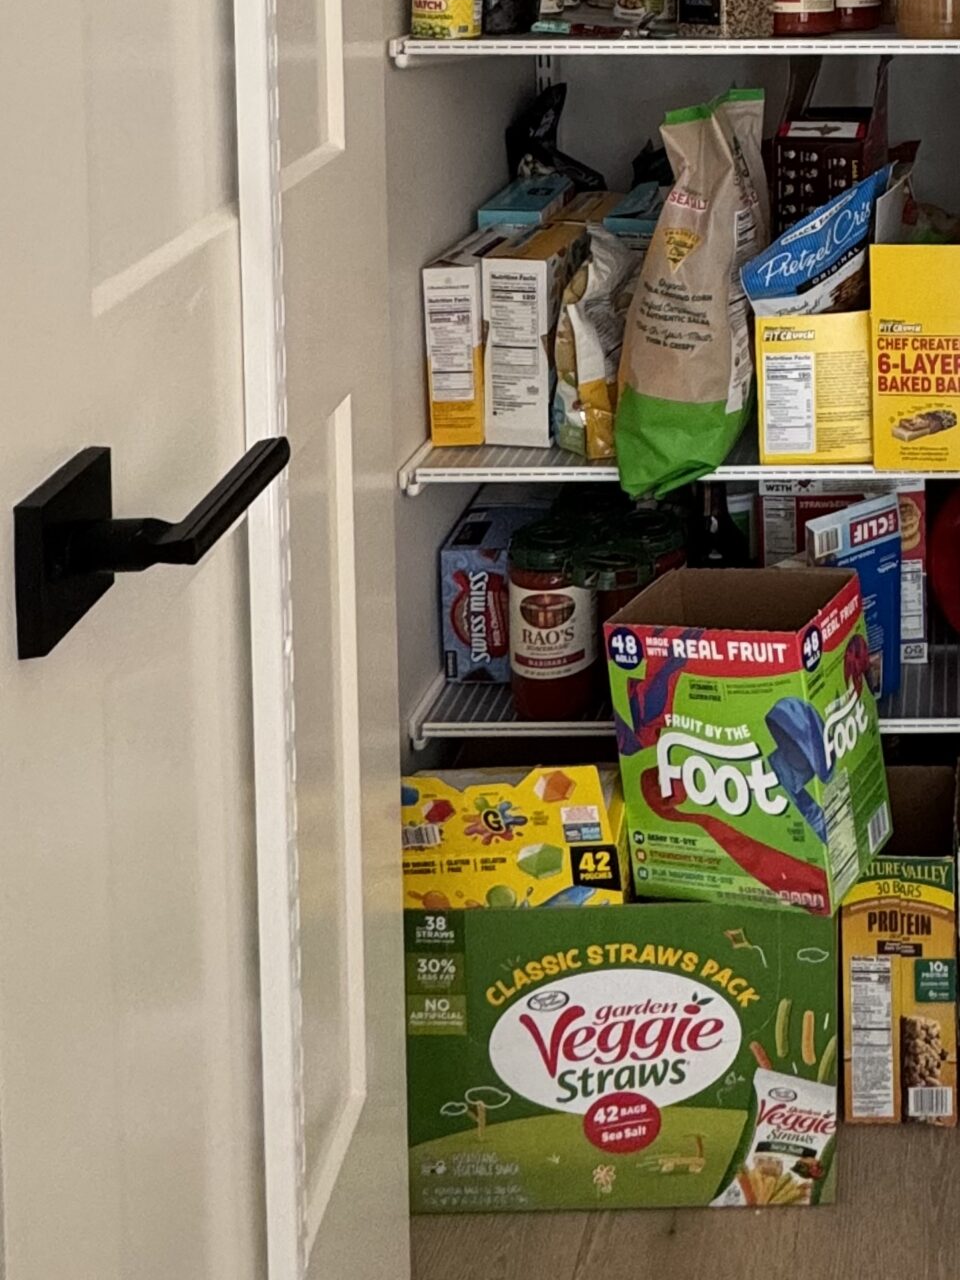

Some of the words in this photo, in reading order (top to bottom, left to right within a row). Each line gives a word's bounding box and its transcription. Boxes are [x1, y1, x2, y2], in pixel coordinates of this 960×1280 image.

[758, 227, 833, 287] Pretzel
[811, 247, 860, 285] ORIGINAL
[877, 337, 909, 351] CHEF
[877, 375, 932, 393] BAKED
[853, 516, 889, 544] CLIF
[821, 618, 840, 643] REAL
[840, 594, 860, 624] FRUIT
[522, 626, 575, 646] RAO'S
[611, 634, 638, 654] 48
[645, 636, 669, 647] MADE
[803, 630, 820, 657] 48
[615, 654, 639, 664] ROLLS
[646, 647, 669, 657] WITH
[672, 639, 724, 661] REAL
[727, 641, 787, 663] FRUIT
[664, 713, 703, 731] FRUIT
[704, 721, 723, 739] BY
[724, 724, 751, 741] THE
[579, 851, 611, 872] 42
[864, 863, 900, 876] ATURE
[900, 865, 949, 884] VALLEY
[875, 881, 890, 896] 30
[892, 881, 922, 898] BARS
[424, 915, 447, 931] 38
[867, 910, 932, 936] PROTEIN
[415, 930, 455, 939] STRAWS
[417, 958, 457, 974] 30%
[485, 947, 583, 1007] CLASSIC
[588, 943, 699, 970] STRAWS
[701, 958, 761, 1008] PACK
[929, 961, 949, 973] 10g
[424, 998, 450, 1012] NO
[592, 998, 678, 1026] garden
[518, 1003, 725, 1080] Veggie
[556, 1058, 687, 1104] Straws
[594, 1105, 619, 1125] 42
[620, 1104, 648, 1117] BAGS
[756, 1099, 837, 1135] Veggie
[601, 1130, 623, 1143] Sea
[624, 1125, 647, 1138] Salt
